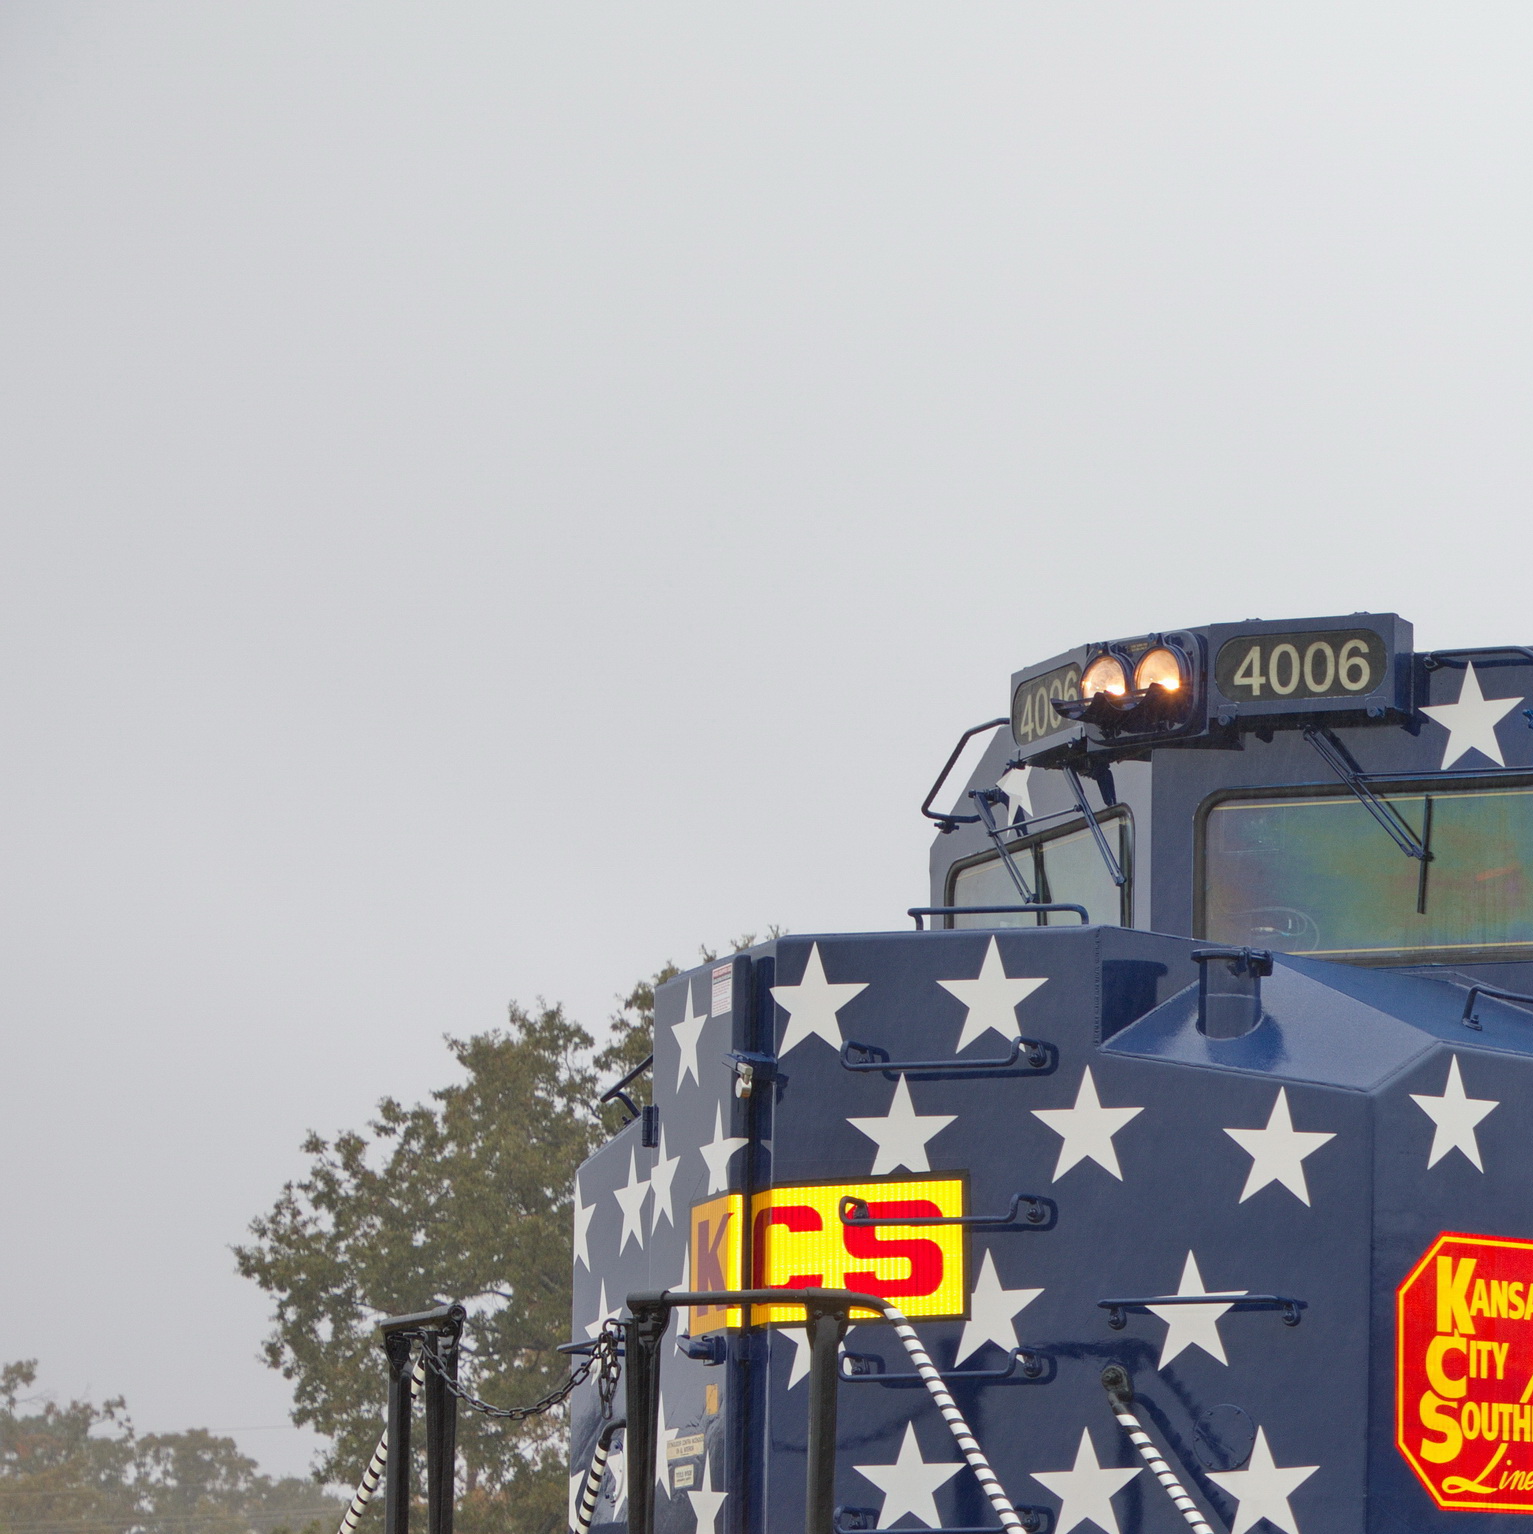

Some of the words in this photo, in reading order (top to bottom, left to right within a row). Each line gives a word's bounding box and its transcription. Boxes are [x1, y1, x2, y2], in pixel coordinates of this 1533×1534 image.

[1234, 639, 1371, 696] 4006
[697, 1199, 944, 1318] KCS
[1425, 1328, 1510, 1399] CITY
